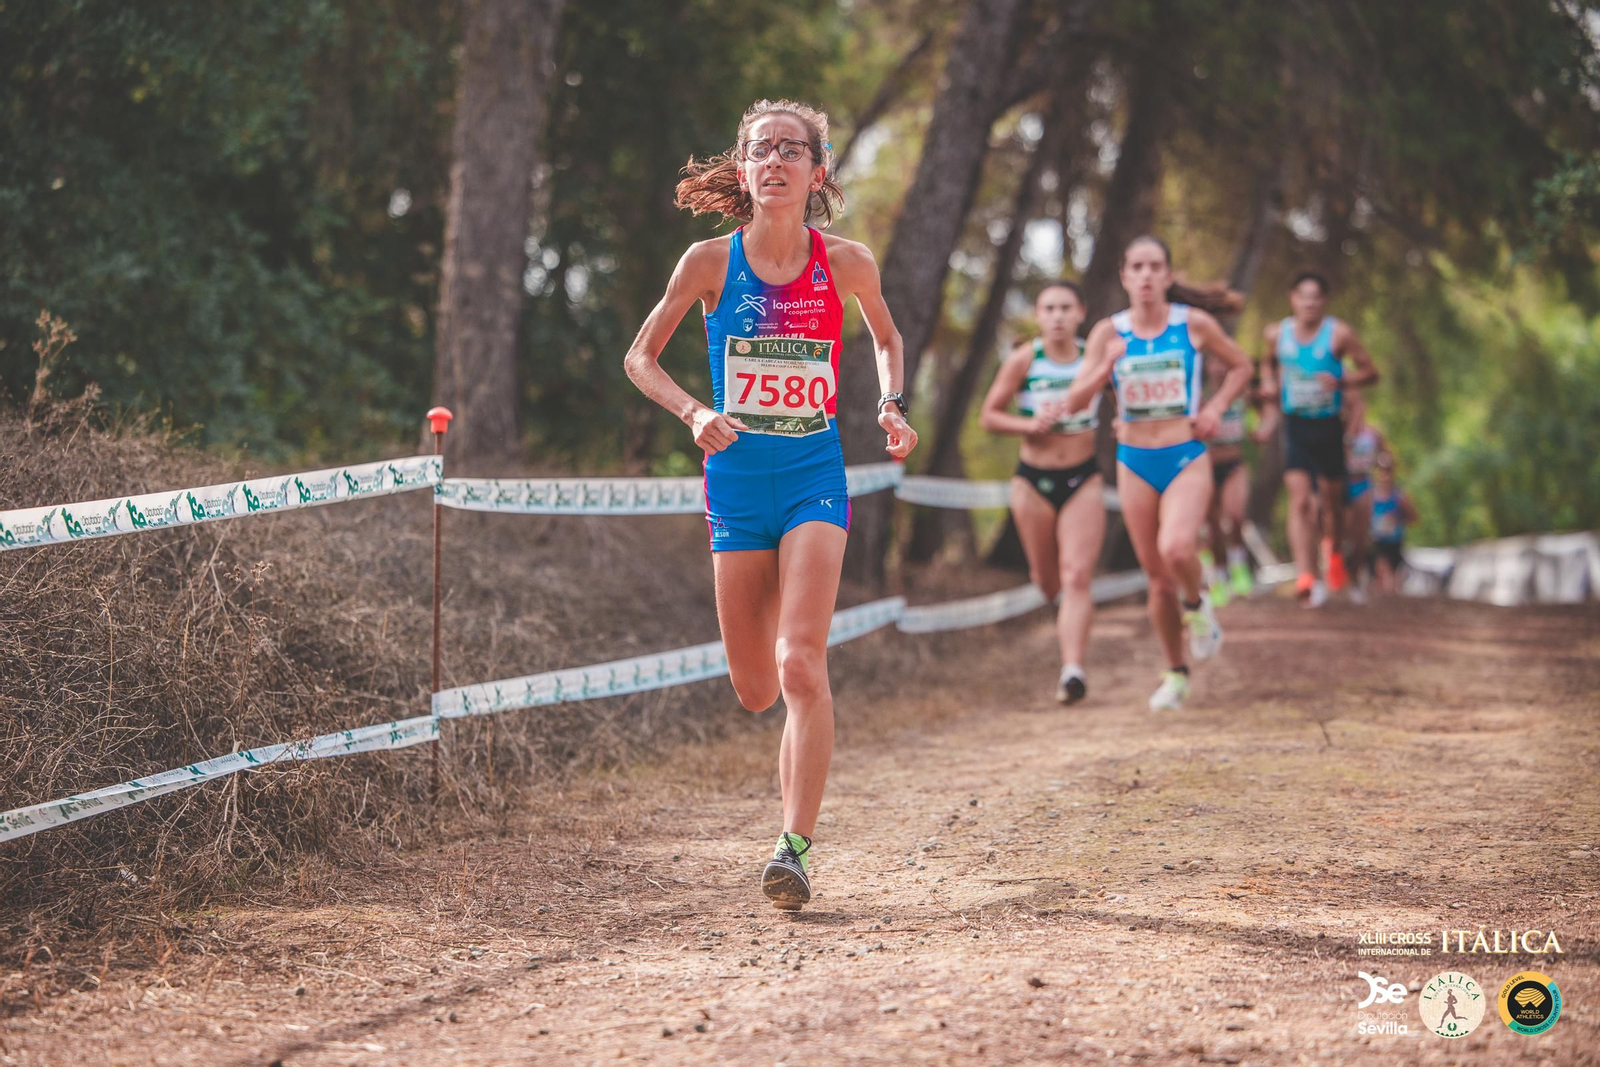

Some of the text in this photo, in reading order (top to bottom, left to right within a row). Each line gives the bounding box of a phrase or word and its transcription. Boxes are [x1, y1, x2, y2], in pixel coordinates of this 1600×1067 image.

[773, 298, 825, 313] lapalma
[788, 308, 826, 317] cooperativa
[759, 340, 808, 354] ITÁLICA
[736, 373, 829, 409] 7580
